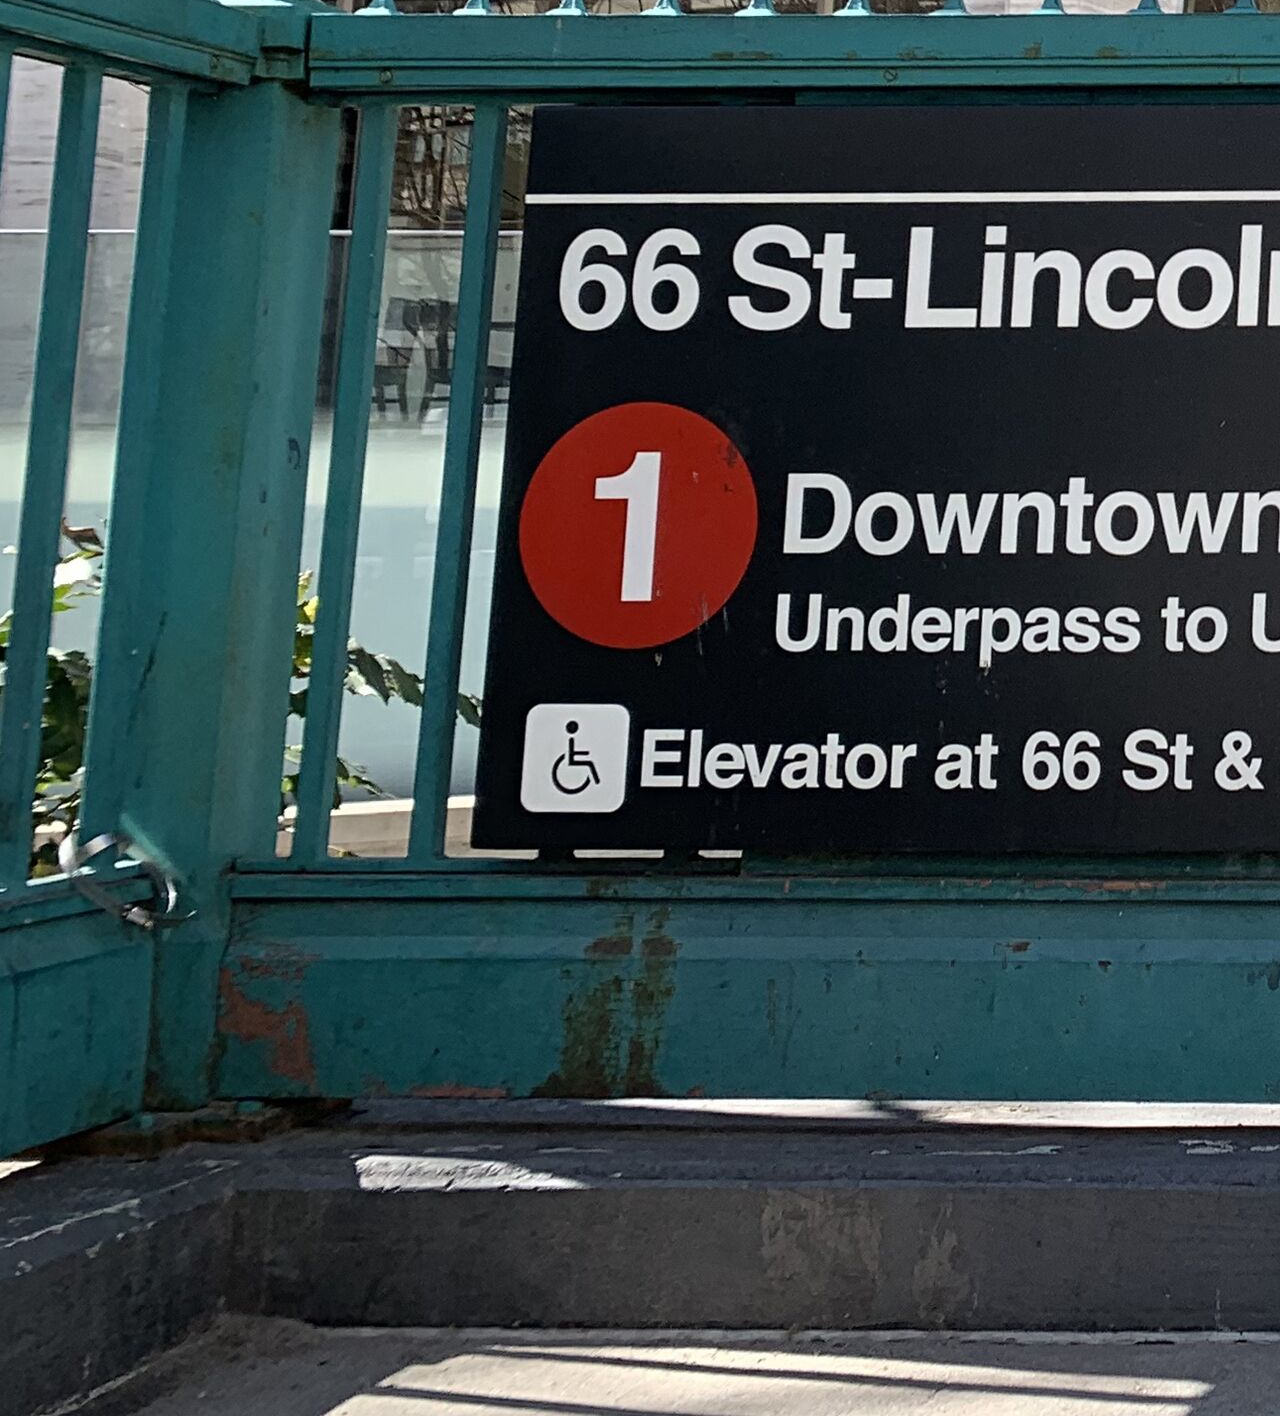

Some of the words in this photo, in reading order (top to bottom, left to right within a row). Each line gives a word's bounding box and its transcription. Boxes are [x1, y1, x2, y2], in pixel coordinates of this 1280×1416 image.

[559, 228, 701, 331] 66
[594, 451, 662, 602] 1
[774, 593, 1141, 668] Underpass
[1160, 596, 1228, 653] to
[640, 728, 918, 790] Elevator
[934, 733, 999, 790] at
[1022, 730, 1101, 791] 66
[1122, 728, 1194, 791] St
[1214, 730, 1265, 791] &
